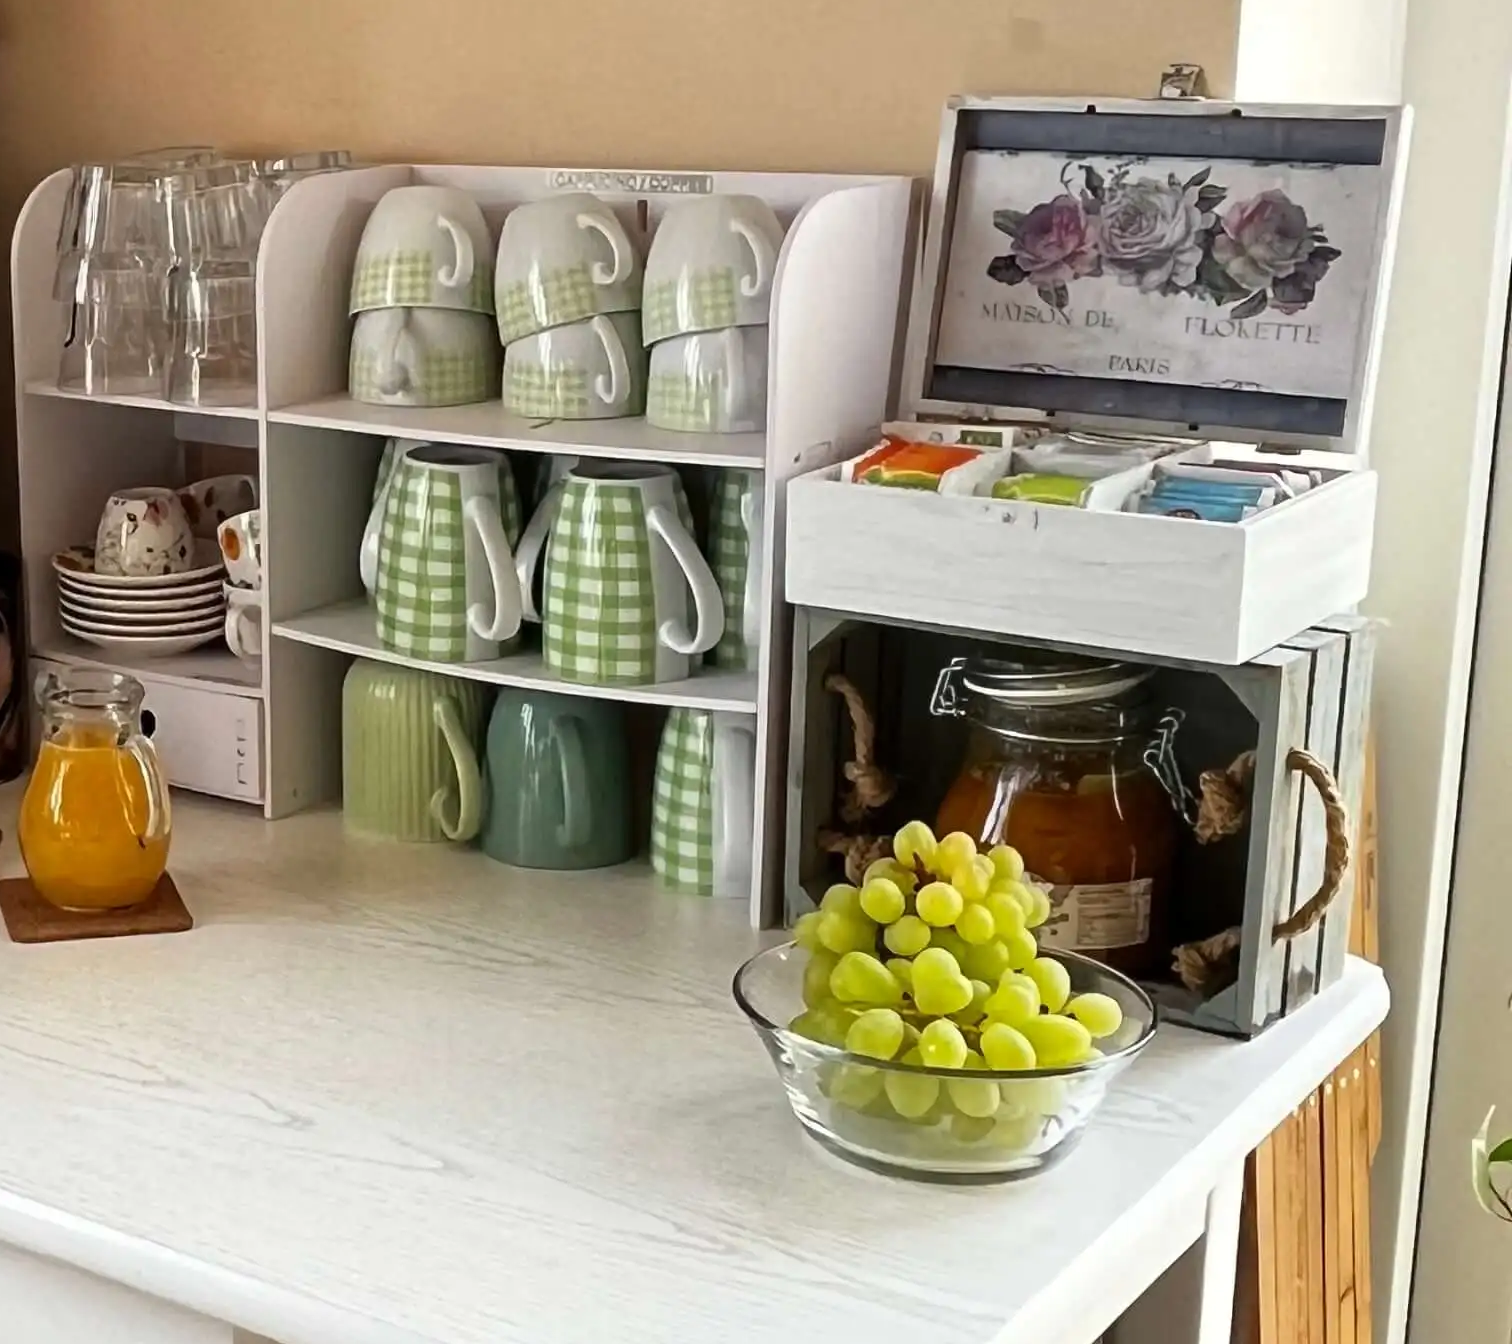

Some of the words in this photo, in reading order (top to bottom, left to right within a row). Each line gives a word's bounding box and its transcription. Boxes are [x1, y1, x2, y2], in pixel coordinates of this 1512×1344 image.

[981, 302, 1073, 327] MAISON
[1086, 309, 1116, 329] DE
[1185, 316, 1321, 345] FLORETTE
[1108, 354, 1170, 375] PARIS
